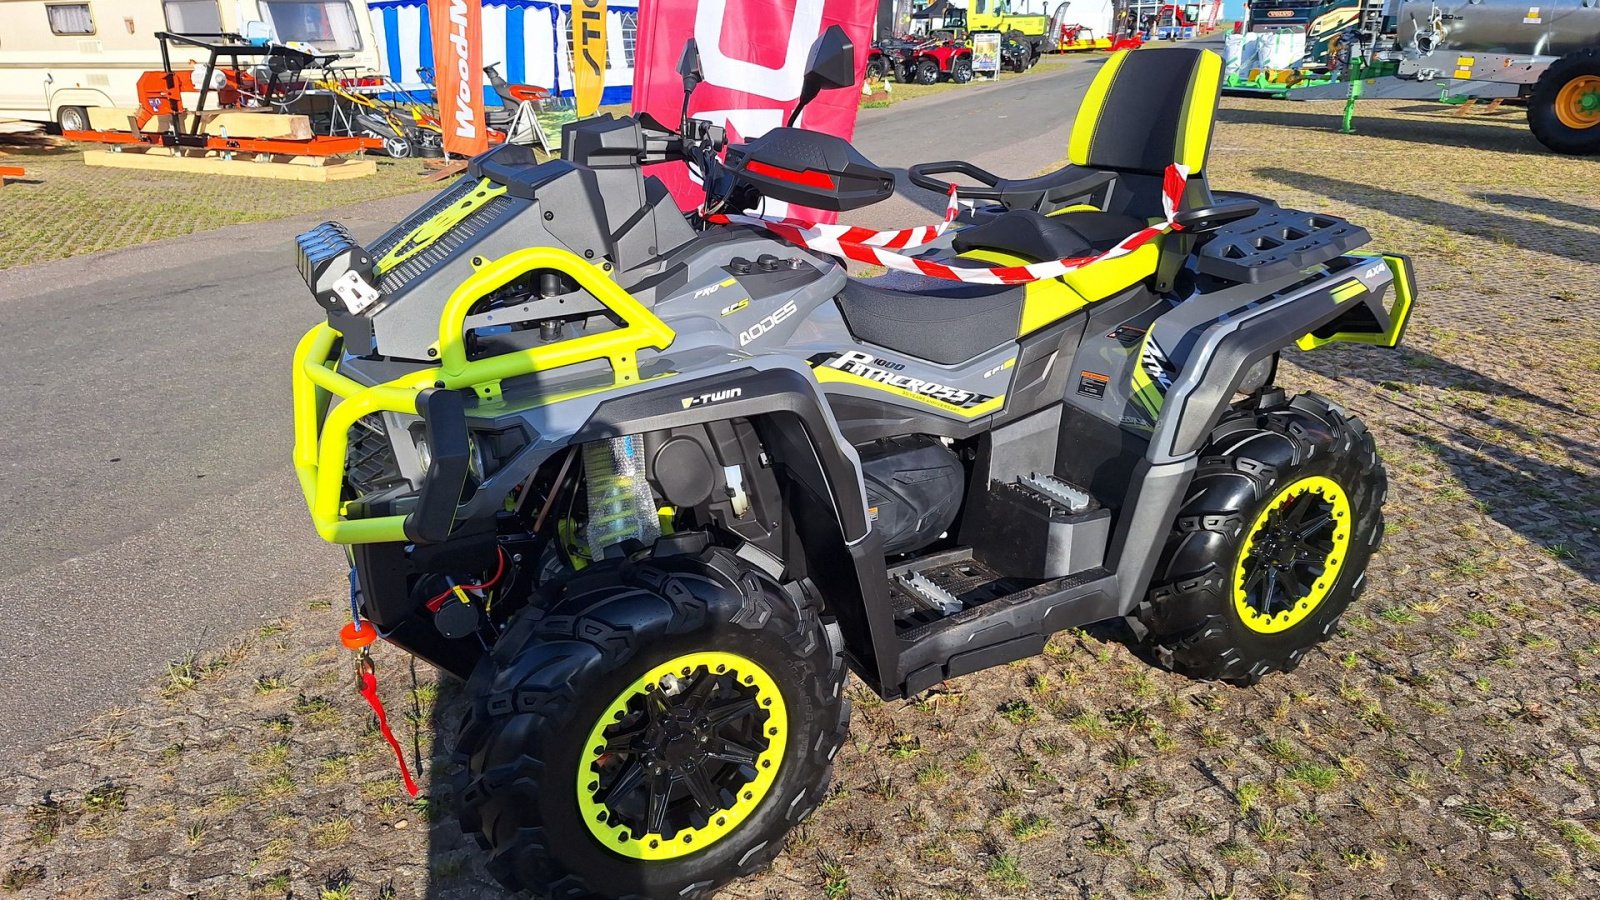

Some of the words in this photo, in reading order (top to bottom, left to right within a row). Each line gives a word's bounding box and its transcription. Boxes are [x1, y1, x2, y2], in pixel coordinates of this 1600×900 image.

[1365, 262, 1386, 279] 4X4
[694, 284, 720, 299] PRO
[740, 300, 798, 346] AODES
[874, 358, 906, 371] 1000
